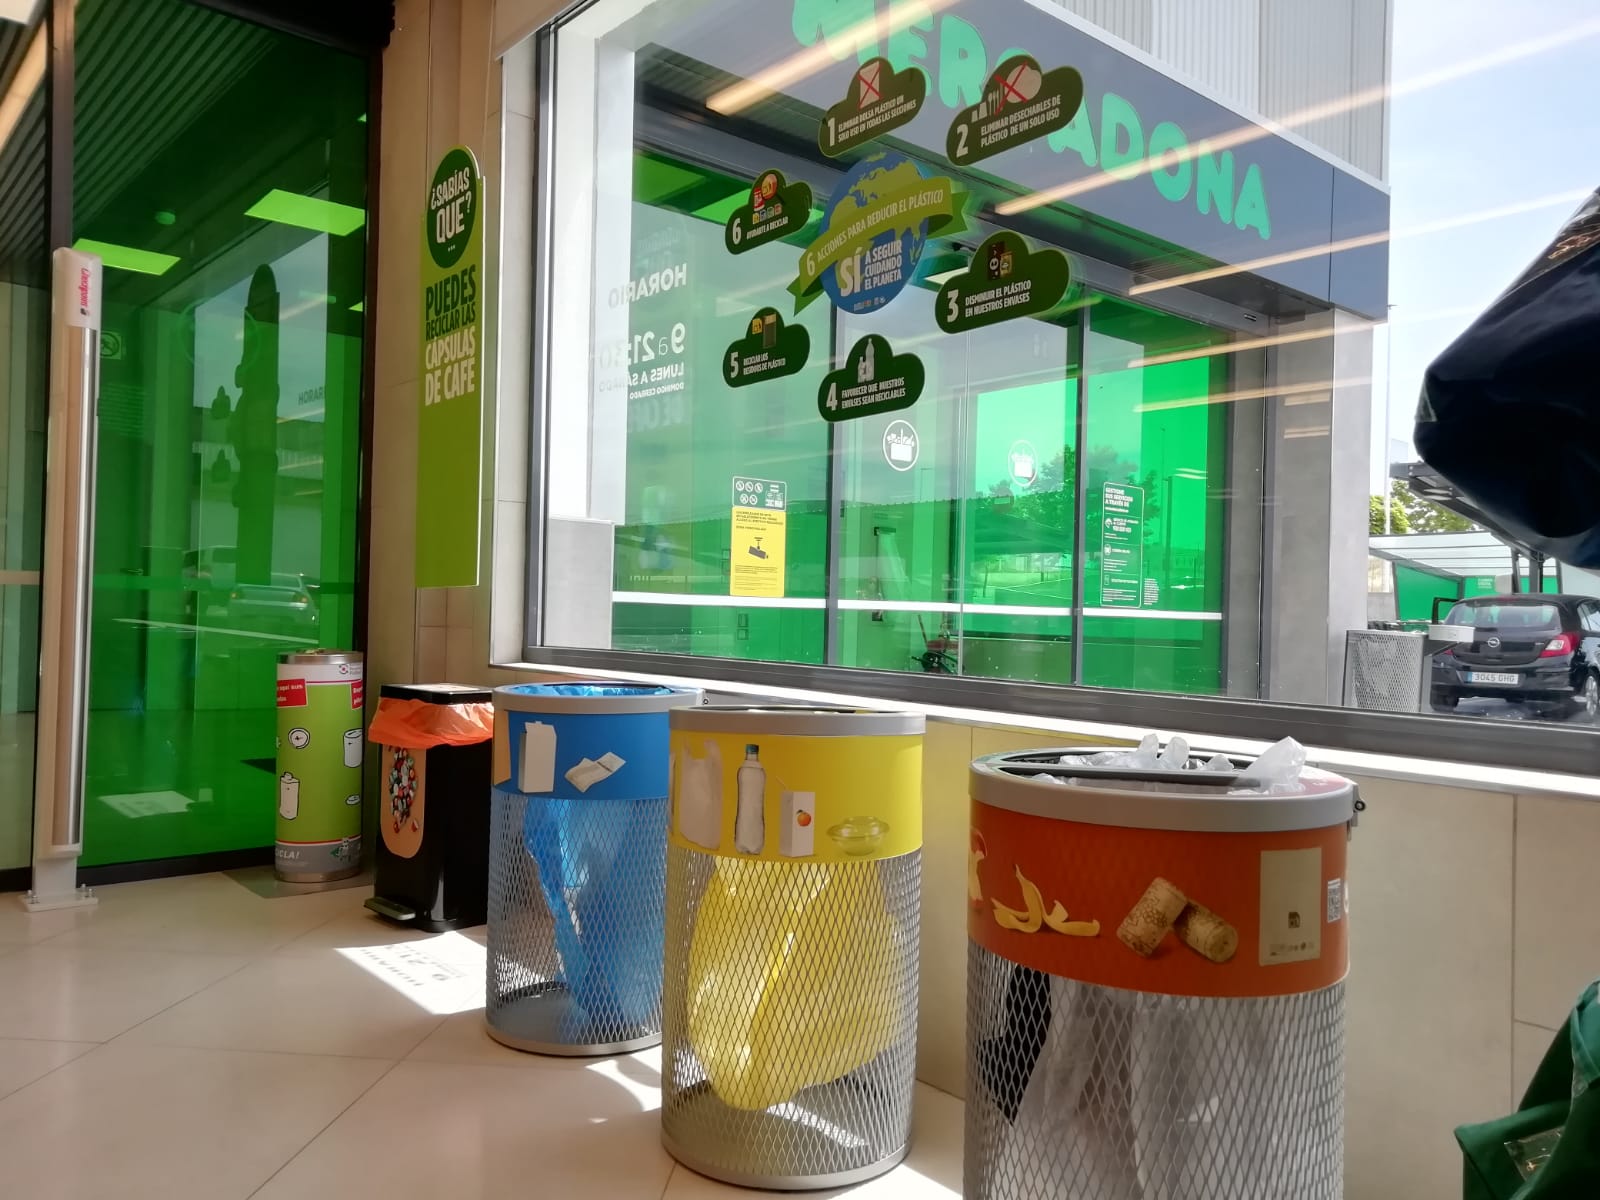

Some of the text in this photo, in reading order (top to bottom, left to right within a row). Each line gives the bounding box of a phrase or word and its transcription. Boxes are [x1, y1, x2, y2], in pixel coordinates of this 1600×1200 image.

[792, 0, 1271, 241] MERADONA
[828, 117, 835, 147] 1
[866, 115, 881, 130] TODAS
[881, 111, 891, 122] LAS
[981, 95, 1061, 136] ELIMINAR DESECHABLES DE
[981, 107, 1060, 148] PLÁSTICO DE UN SOLO USO
[956, 124, 968, 158] 2
[431, 167, 470, 210] ¿SABÍAS
[732, 218, 741, 245] 6
[806, 189, 944, 277] 6 ACCIONES PARA REDUCIR EL PLÁSTICO
[865, 239, 902, 265] A SEGUIR
[865, 255, 902, 276] CUIDANDO
[840, 246, 862, 298] SÍ
[864, 269, 902, 290] EL PLANETA
[426, 264, 476, 321] PUEDES
[947, 289, 959, 323] 3
[965, 280, 1031, 306] DISMINUIR EL PLÁSTICO
[965, 292, 1030, 318] EN NUESTROS ENVASES
[425, 301, 476, 341] RECICLAR LAS
[425, 326, 475, 370] CÁPSULAS
[730, 352, 739, 379] 5
[425, 369, 441, 406] DE
[826, 382, 838, 411] 4
[868, 383, 878, 393] QUE
[879, 377, 905, 391] NUESTROS
